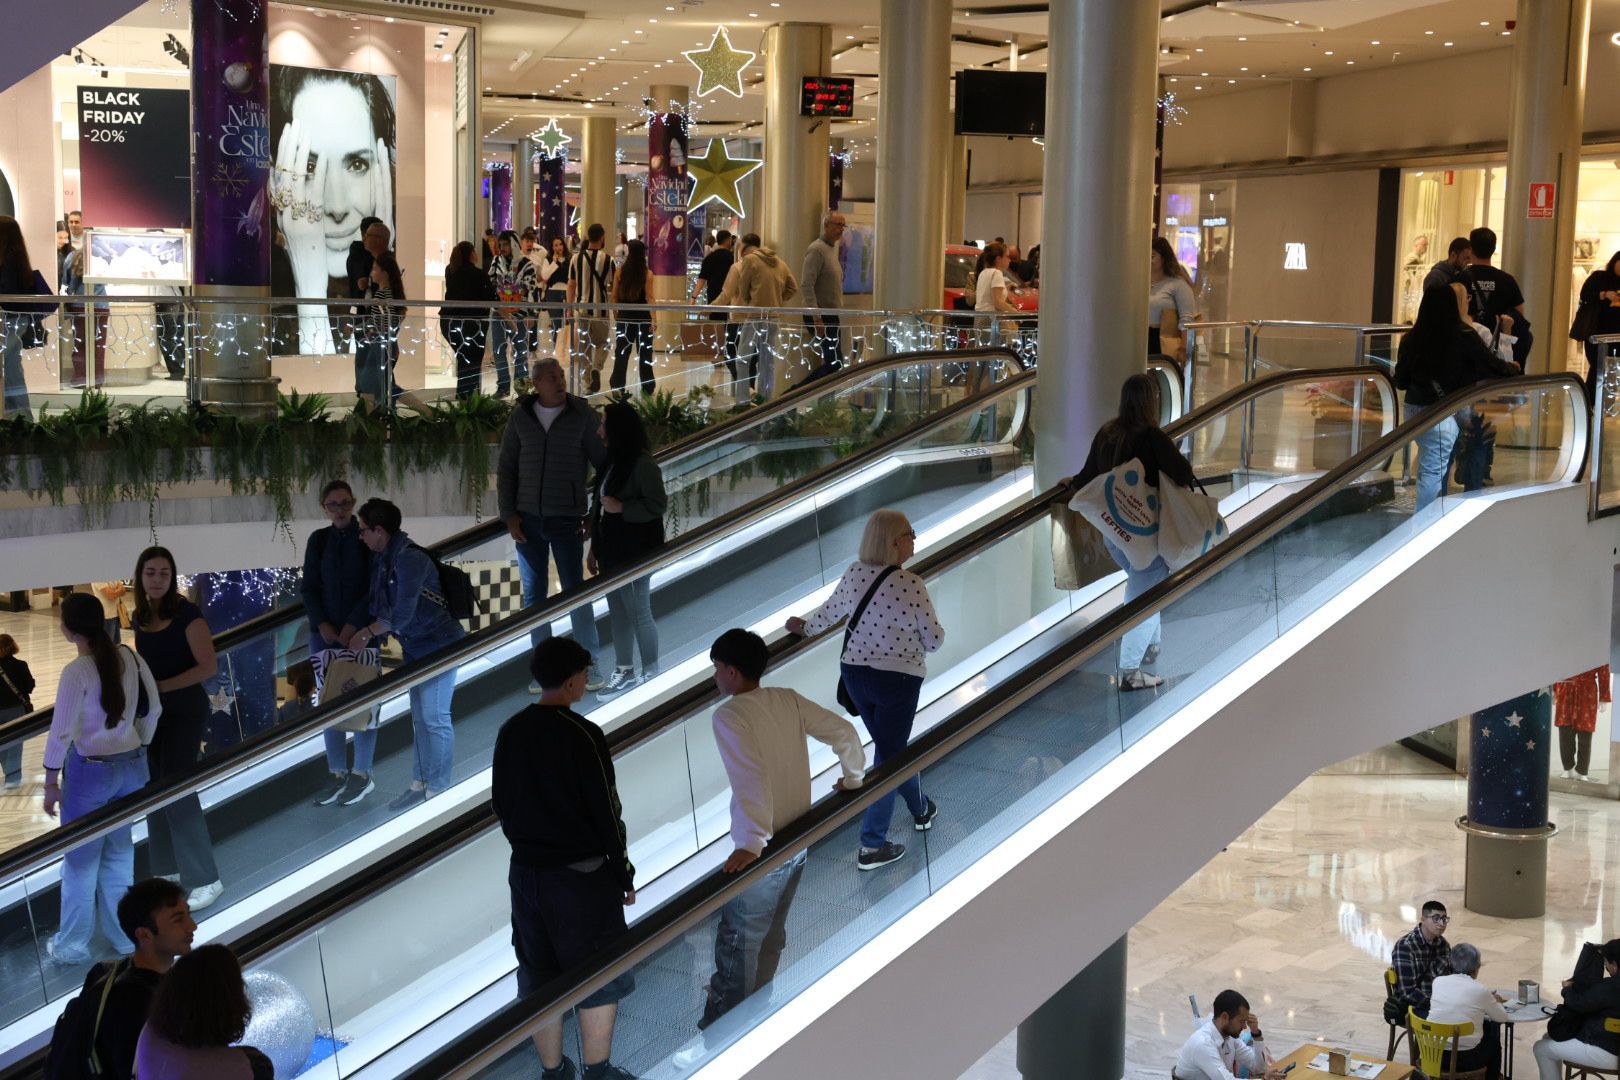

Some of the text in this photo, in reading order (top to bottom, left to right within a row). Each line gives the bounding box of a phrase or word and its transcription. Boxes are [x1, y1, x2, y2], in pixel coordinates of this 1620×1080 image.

[82, 91, 141, 106] BLACK
[83, 110, 146, 125] FRIDAY
[1101, 511, 1132, 542] LEFTIES
